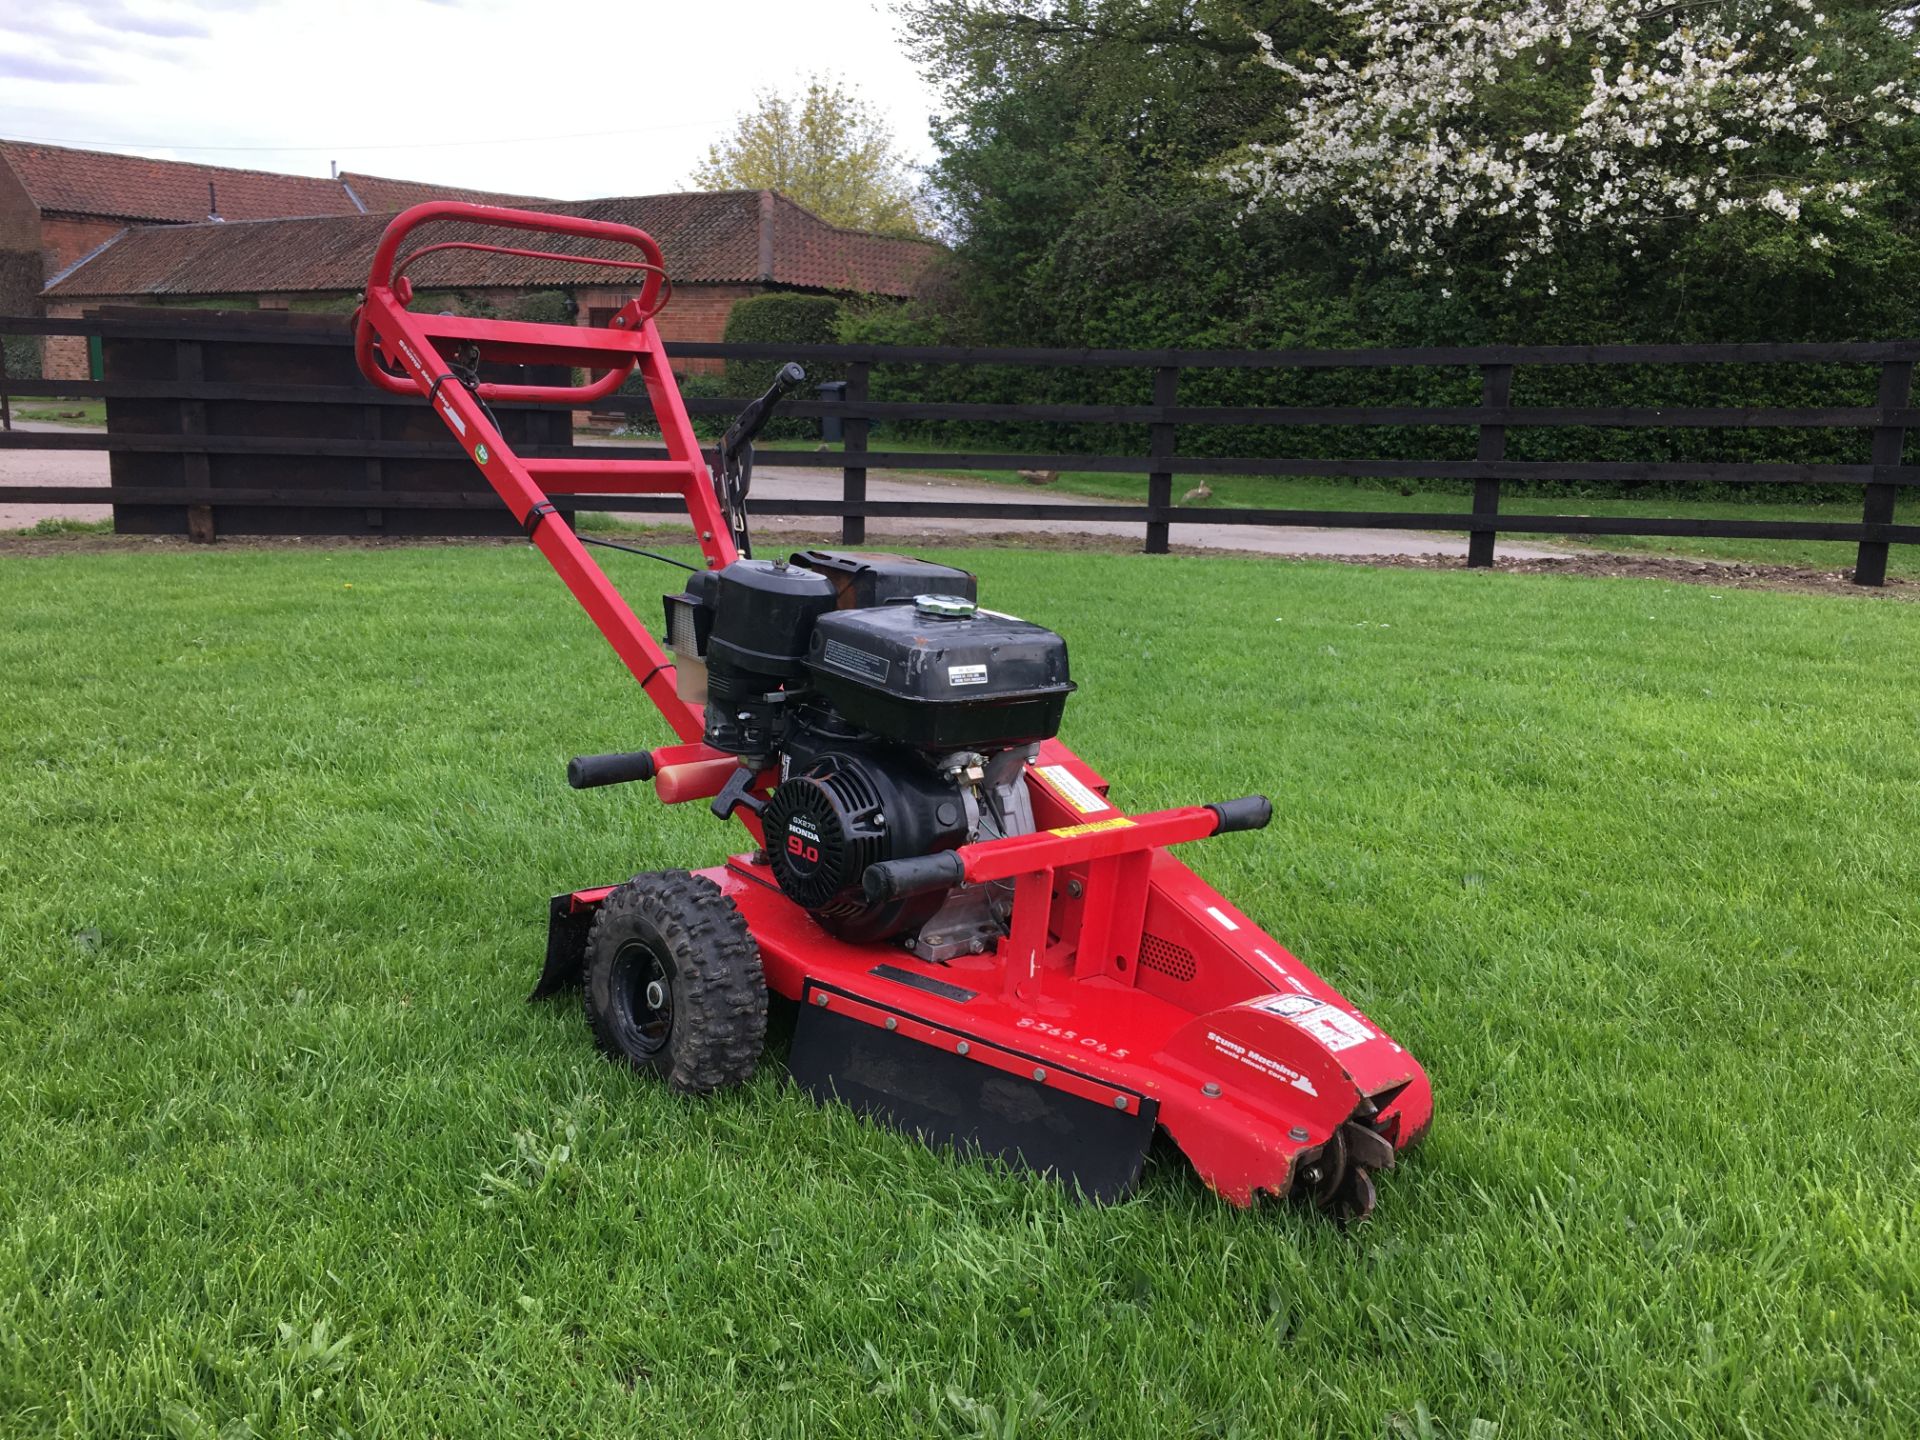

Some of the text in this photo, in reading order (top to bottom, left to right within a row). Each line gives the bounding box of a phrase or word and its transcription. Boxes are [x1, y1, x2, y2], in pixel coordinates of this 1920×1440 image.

[792, 816, 816, 831] GX270
[789, 824, 820, 843] HONDA
[788, 834, 819, 863] 9.0
[1207, 1032, 1299, 1079] Stump Machine
[1241, 1057, 1267, 1073] Illinois
